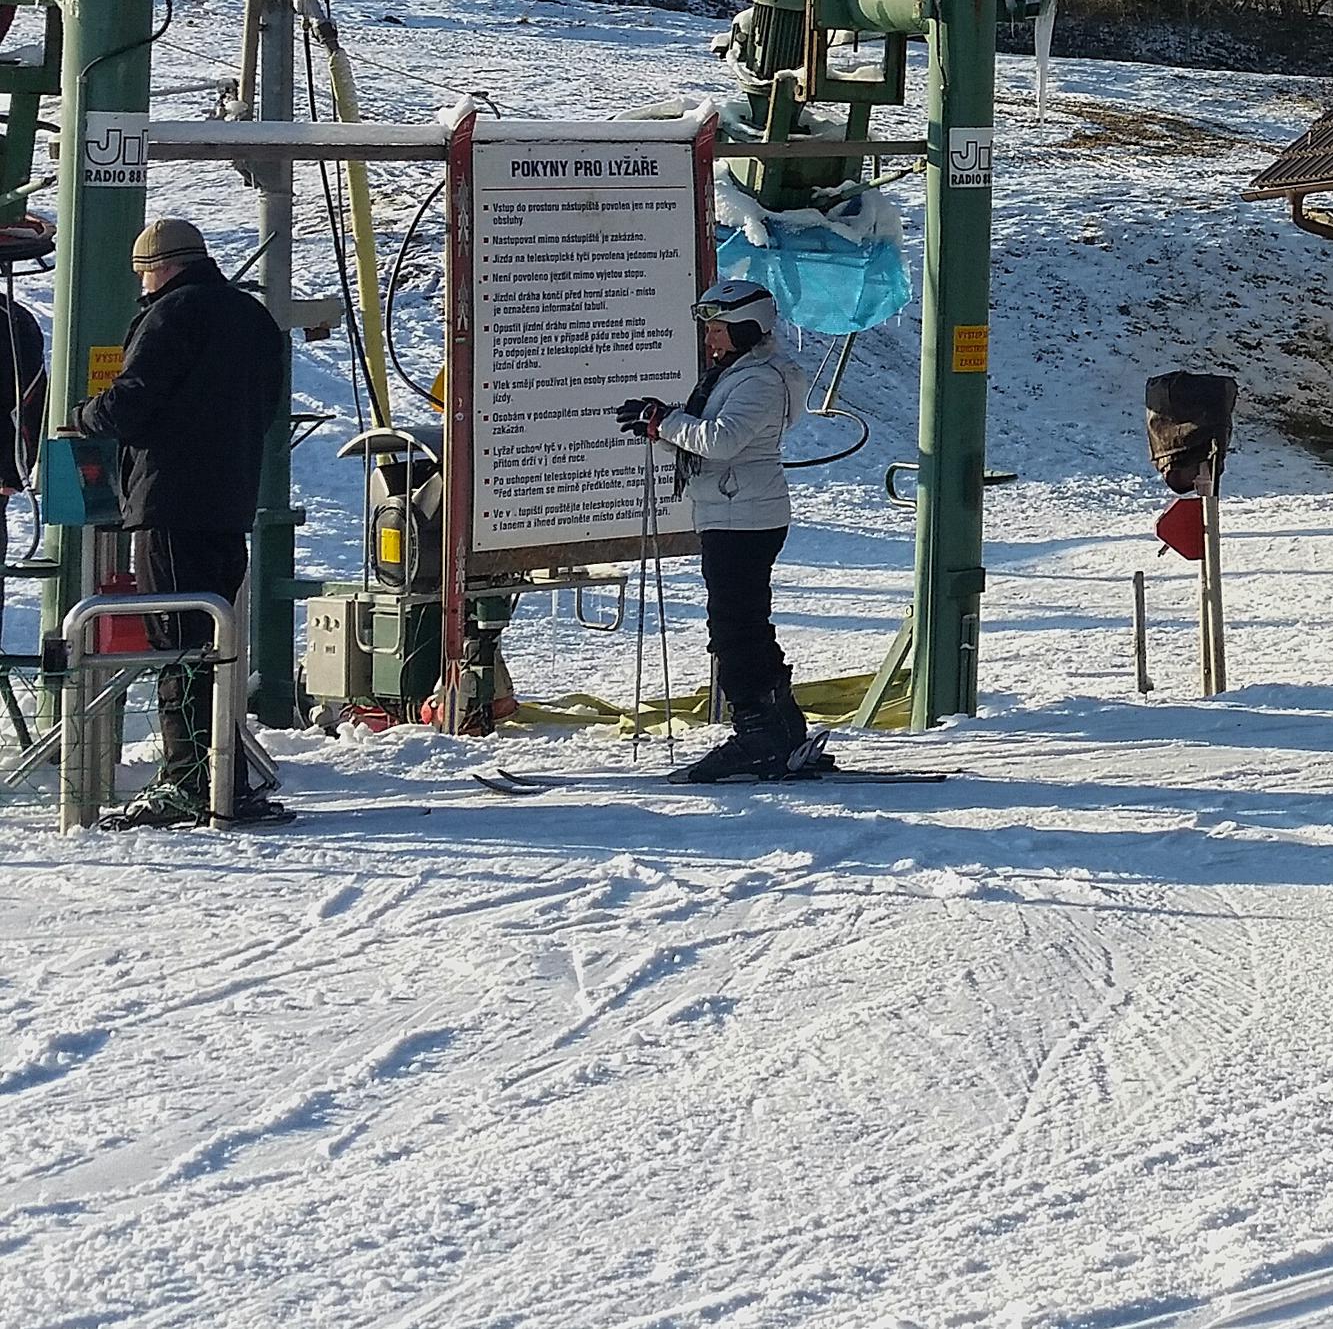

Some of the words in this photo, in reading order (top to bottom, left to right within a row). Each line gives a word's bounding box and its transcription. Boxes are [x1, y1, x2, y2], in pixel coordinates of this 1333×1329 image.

[511, 160, 568, 177] POKYNY
[574, 160, 602, 176] PRO
[609, 156, 659, 176] LYŽAŘE
[85, 170, 126, 183] RADIO
[951, 174, 982, 185] RADIO
[493, 203, 514, 213] Vstup
[517, 203, 526, 211] do
[493, 235, 536, 246] Nastupovat
[538, 235, 559, 243] mimo
[493, 274, 510, 282] Není
[513, 273, 548, 283] povoleno
[569, 320, 590, 329] mimo
